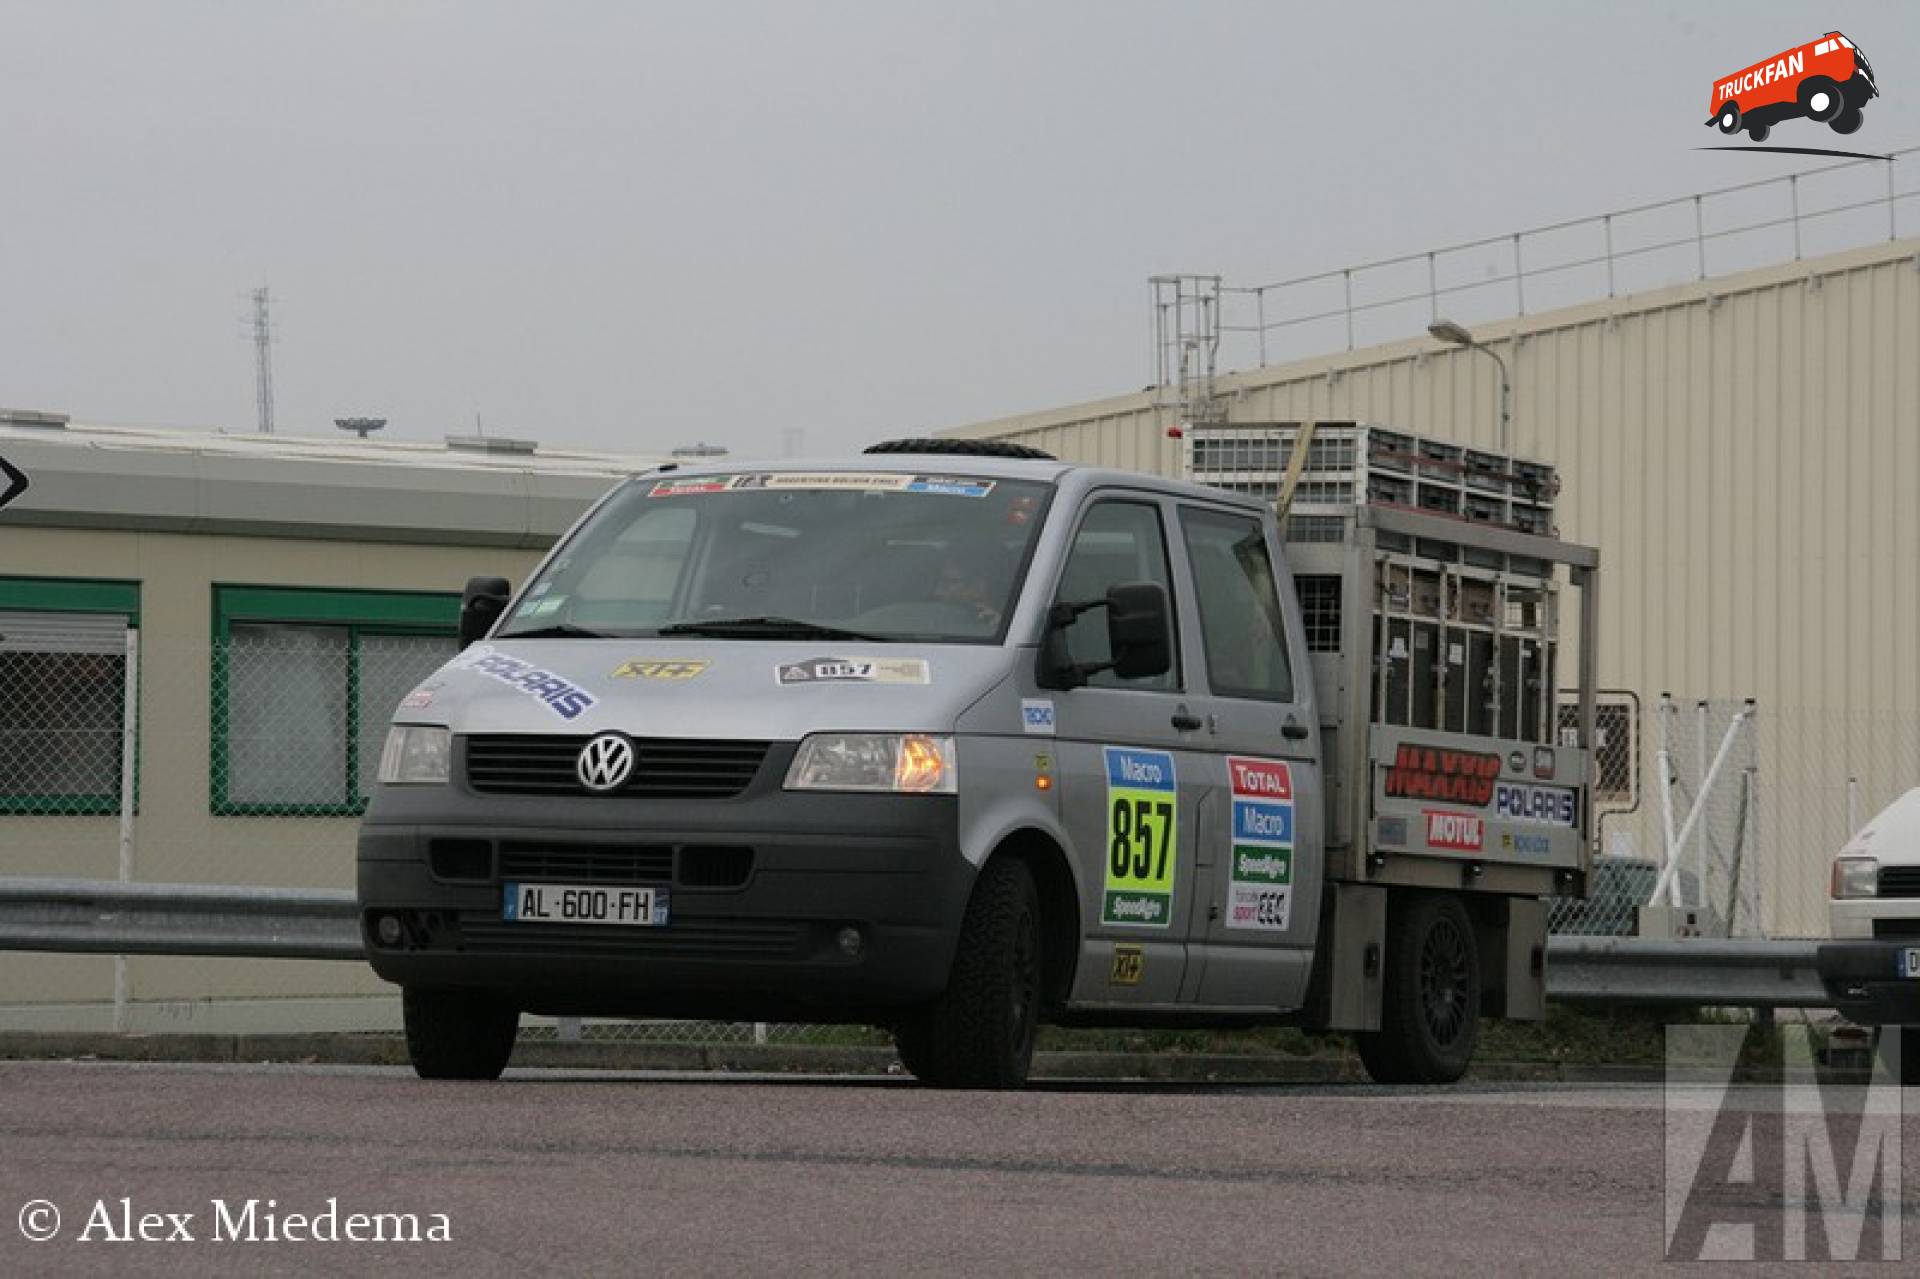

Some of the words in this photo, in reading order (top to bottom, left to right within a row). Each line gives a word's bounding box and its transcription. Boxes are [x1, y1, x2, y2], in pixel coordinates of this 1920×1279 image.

[820, 663, 872, 678] 857
[470, 655, 595, 720] POLARIS
[1120, 756, 1162, 784] Macro
[1235, 765, 1286, 793] TOTAL
[1497, 786, 1573, 822] POLARIS
[1243, 806, 1285, 835] Macro
[1430, 814, 1480, 845] MOTUL
[1111, 798, 1173, 881] 857
